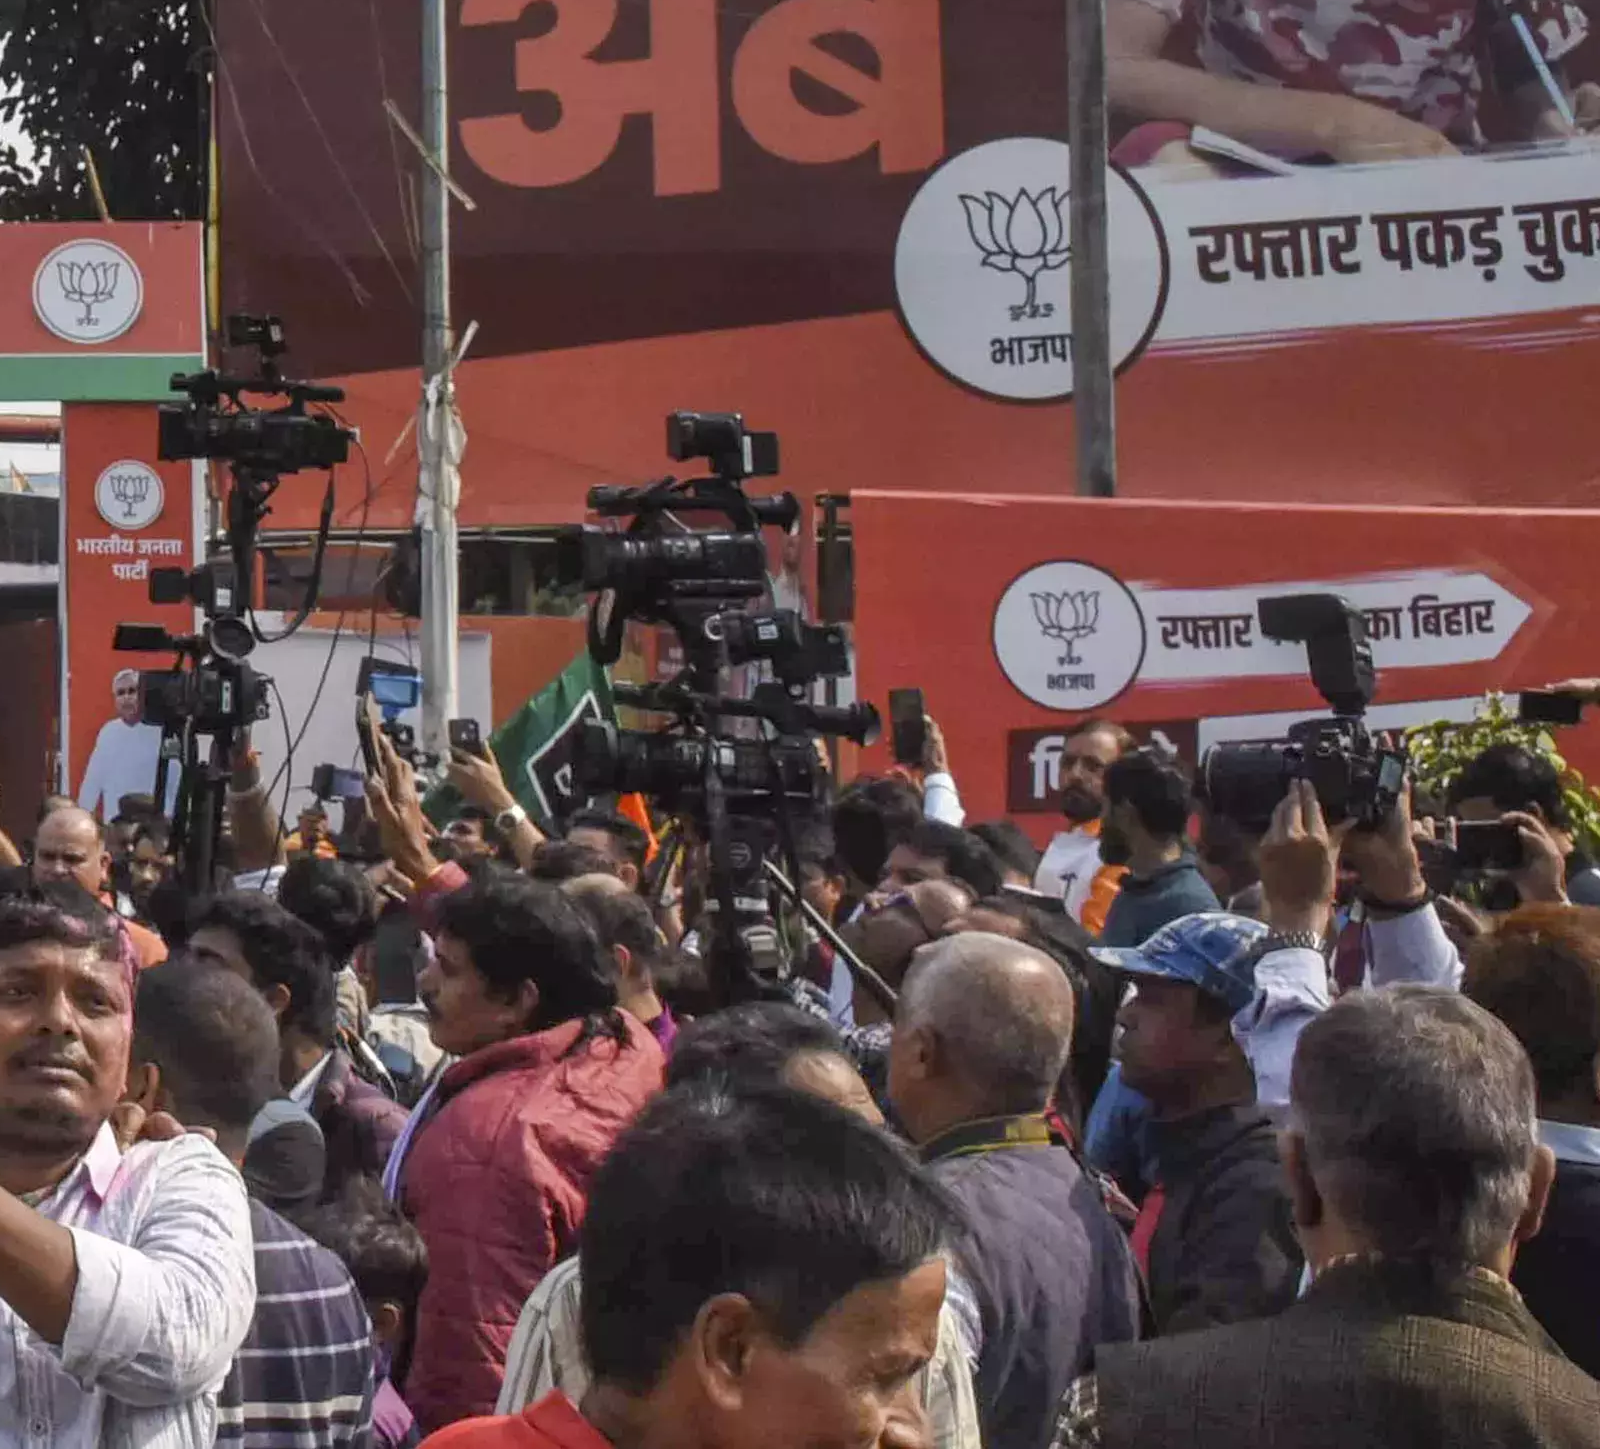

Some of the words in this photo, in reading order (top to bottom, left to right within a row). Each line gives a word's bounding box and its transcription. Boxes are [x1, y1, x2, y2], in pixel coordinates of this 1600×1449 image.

[1187, 214, 1363, 285] रफ्तार
[1369, 204, 1505, 283] पकड़
[989, 332, 1074, 366] भाजप
[76, 534, 135, 556] भारतीय
[137, 537, 183, 556] जनता
[111, 559, 149, 580] पार्टी
[1157, 613, 1254, 651] रफ्तार
[1408, 594, 1496, 640] बिहार
[1045, 671, 1096, 693] भाजपा
